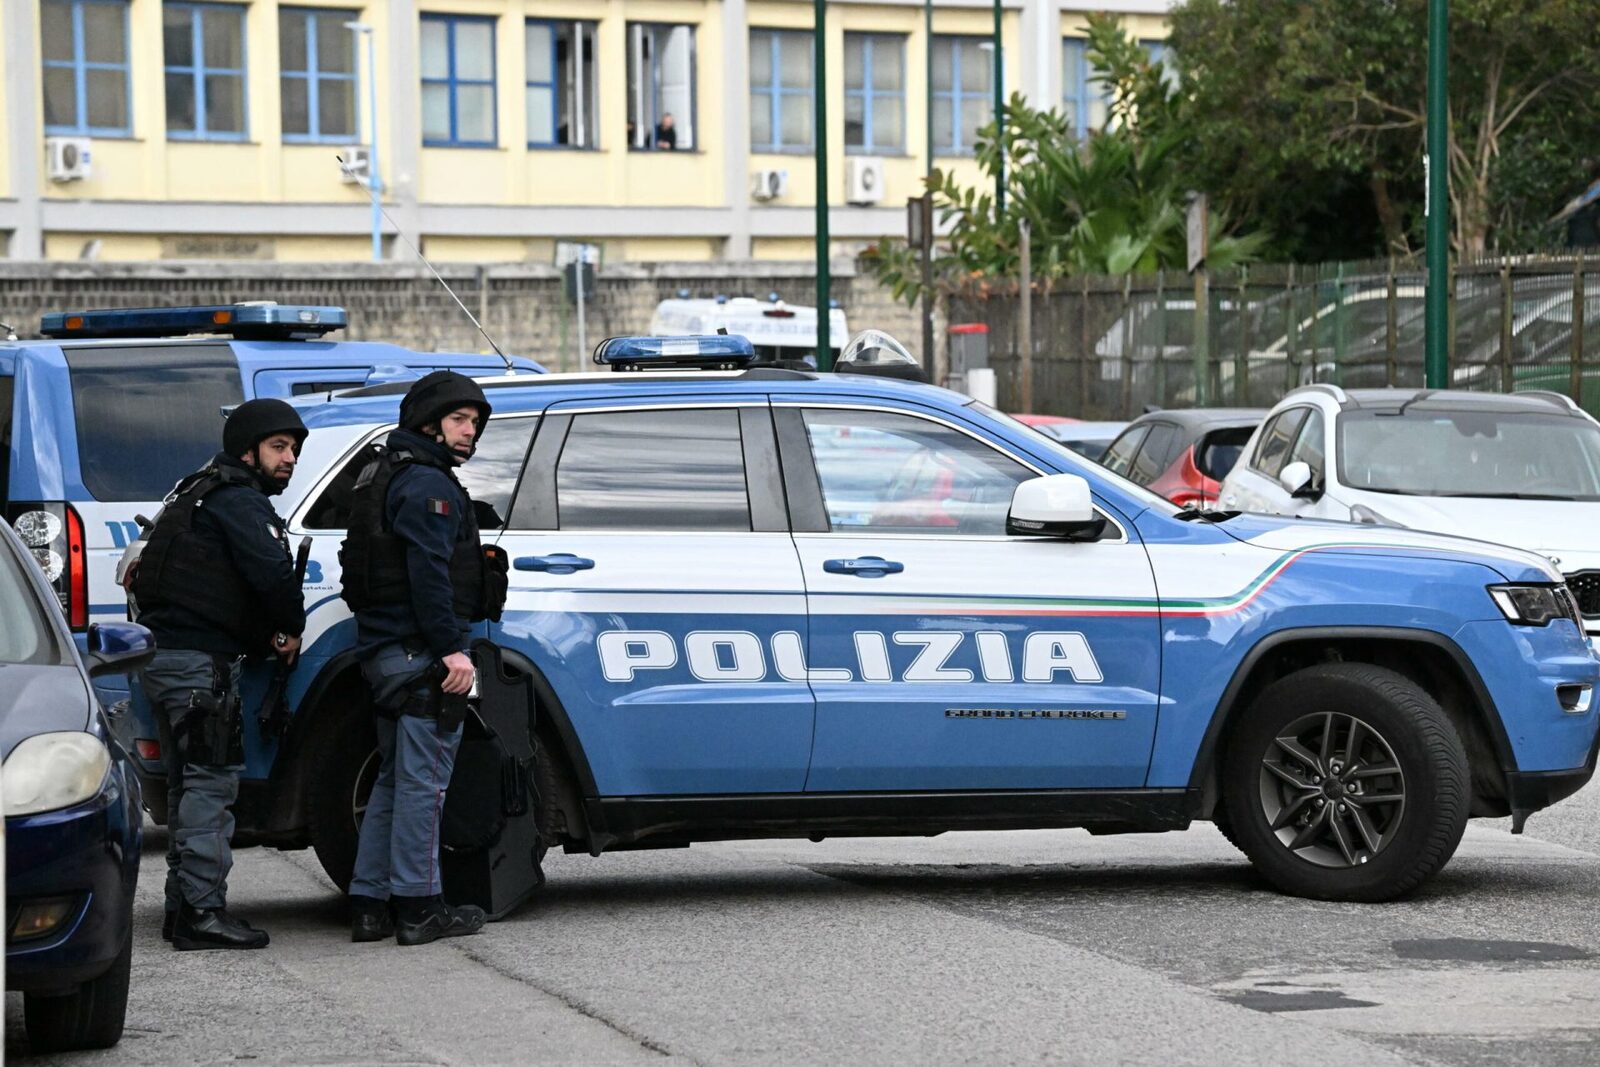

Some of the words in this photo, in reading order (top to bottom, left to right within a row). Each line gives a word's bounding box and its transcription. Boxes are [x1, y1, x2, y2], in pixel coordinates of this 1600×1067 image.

[596, 630, 1104, 683] POLIZIA
[945, 708, 1015, 719] GRAND
[1018, 709, 1127, 720] CHEROKEE
